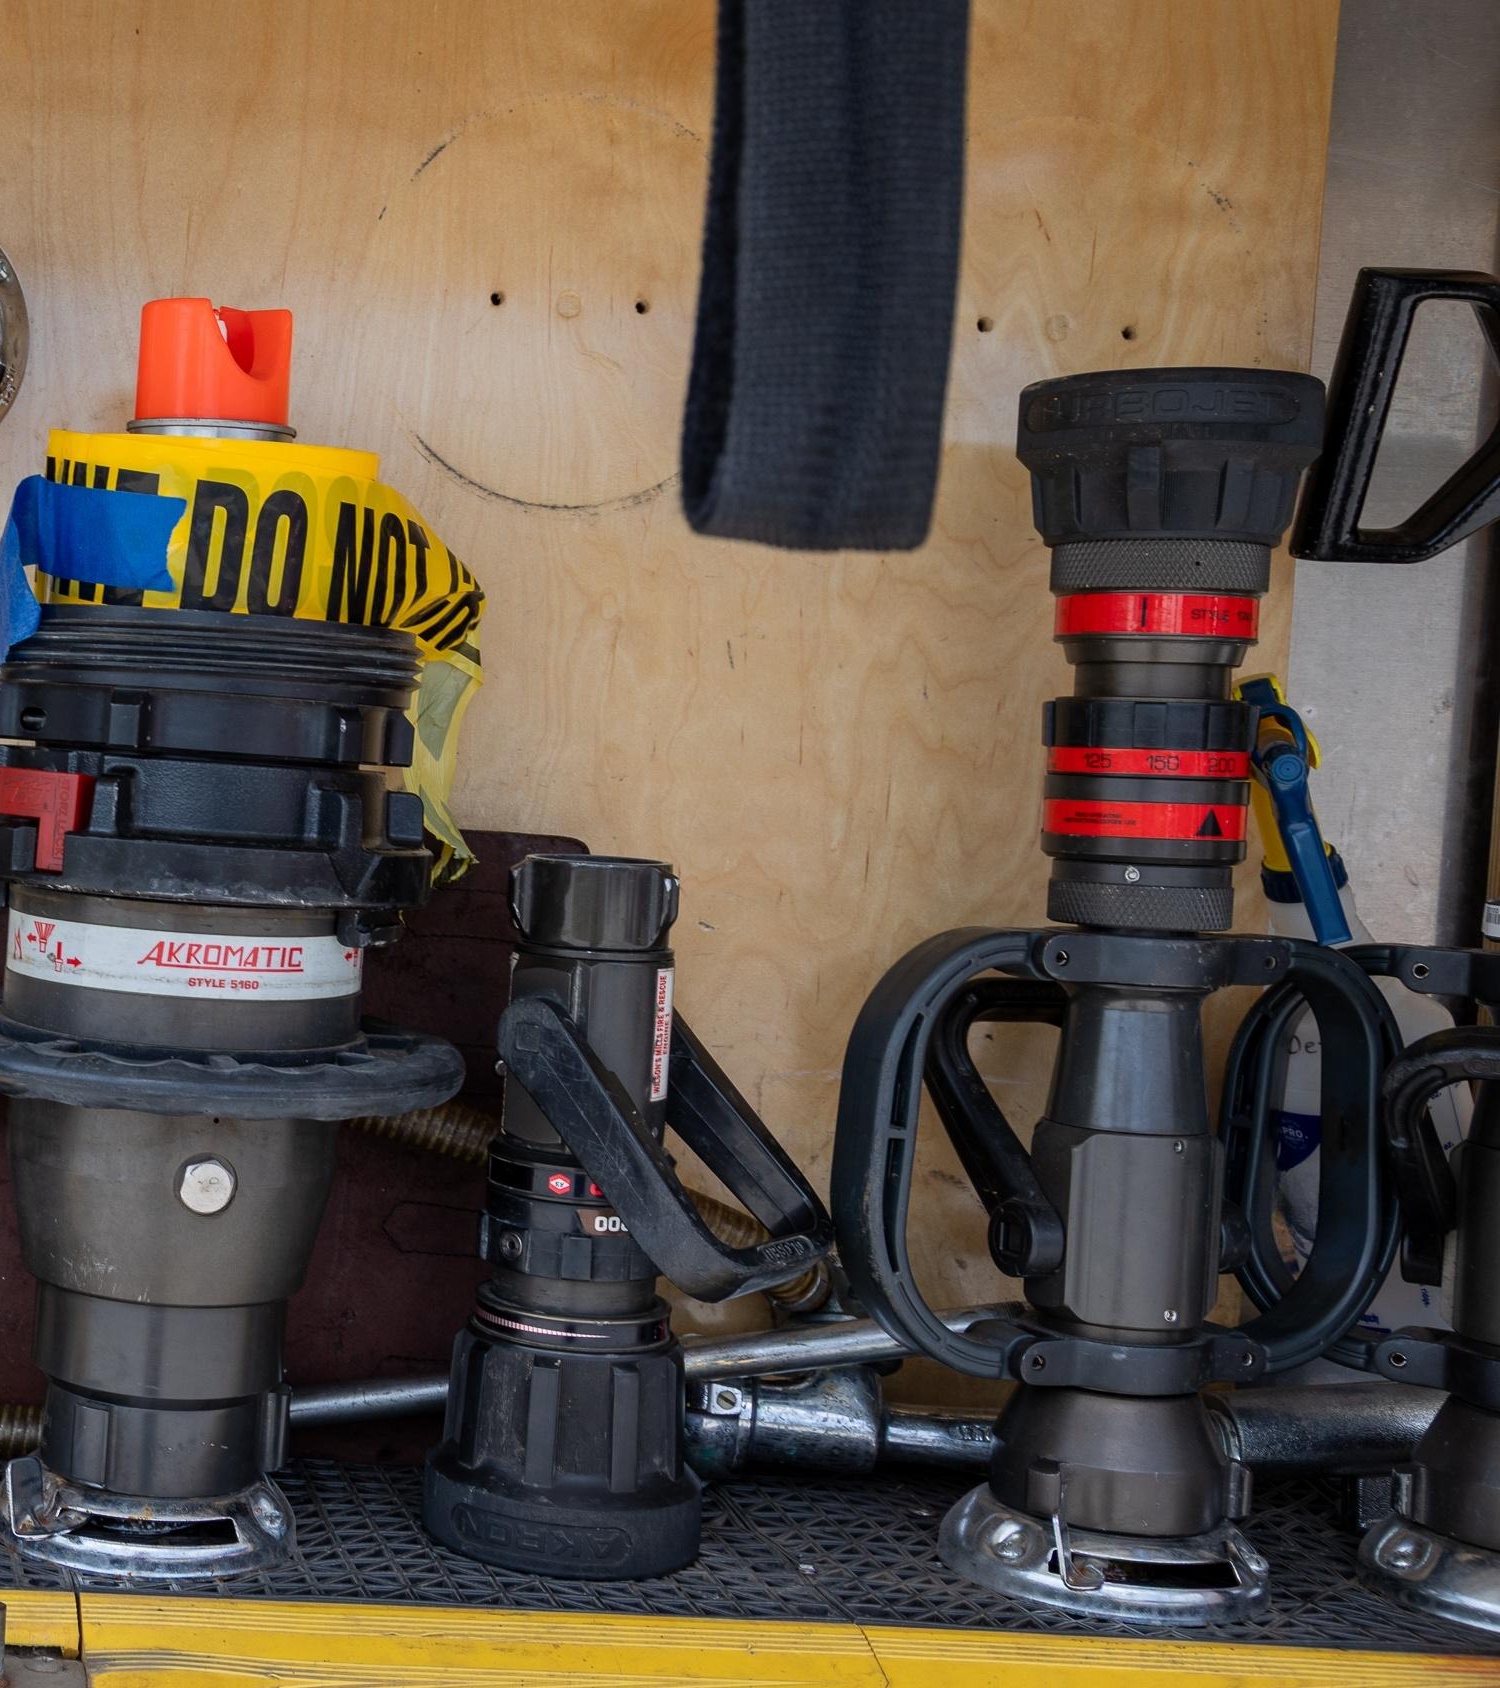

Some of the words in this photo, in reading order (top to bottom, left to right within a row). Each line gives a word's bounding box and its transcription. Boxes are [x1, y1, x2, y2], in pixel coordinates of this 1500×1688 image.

[179, 479, 308, 618] DO
[326, 502, 432, 627] NOT
[1084, 753, 1112, 769] 125
[1146, 755, 1180, 771] 150
[1208, 757, 1236, 773] 200
[137, 940, 304, 972] AKROMATIC
[188, 977, 226, 989] STYLE
[658, 975, 668, 1005] RESCUE
[1287, 1035, 1322, 1055] De
